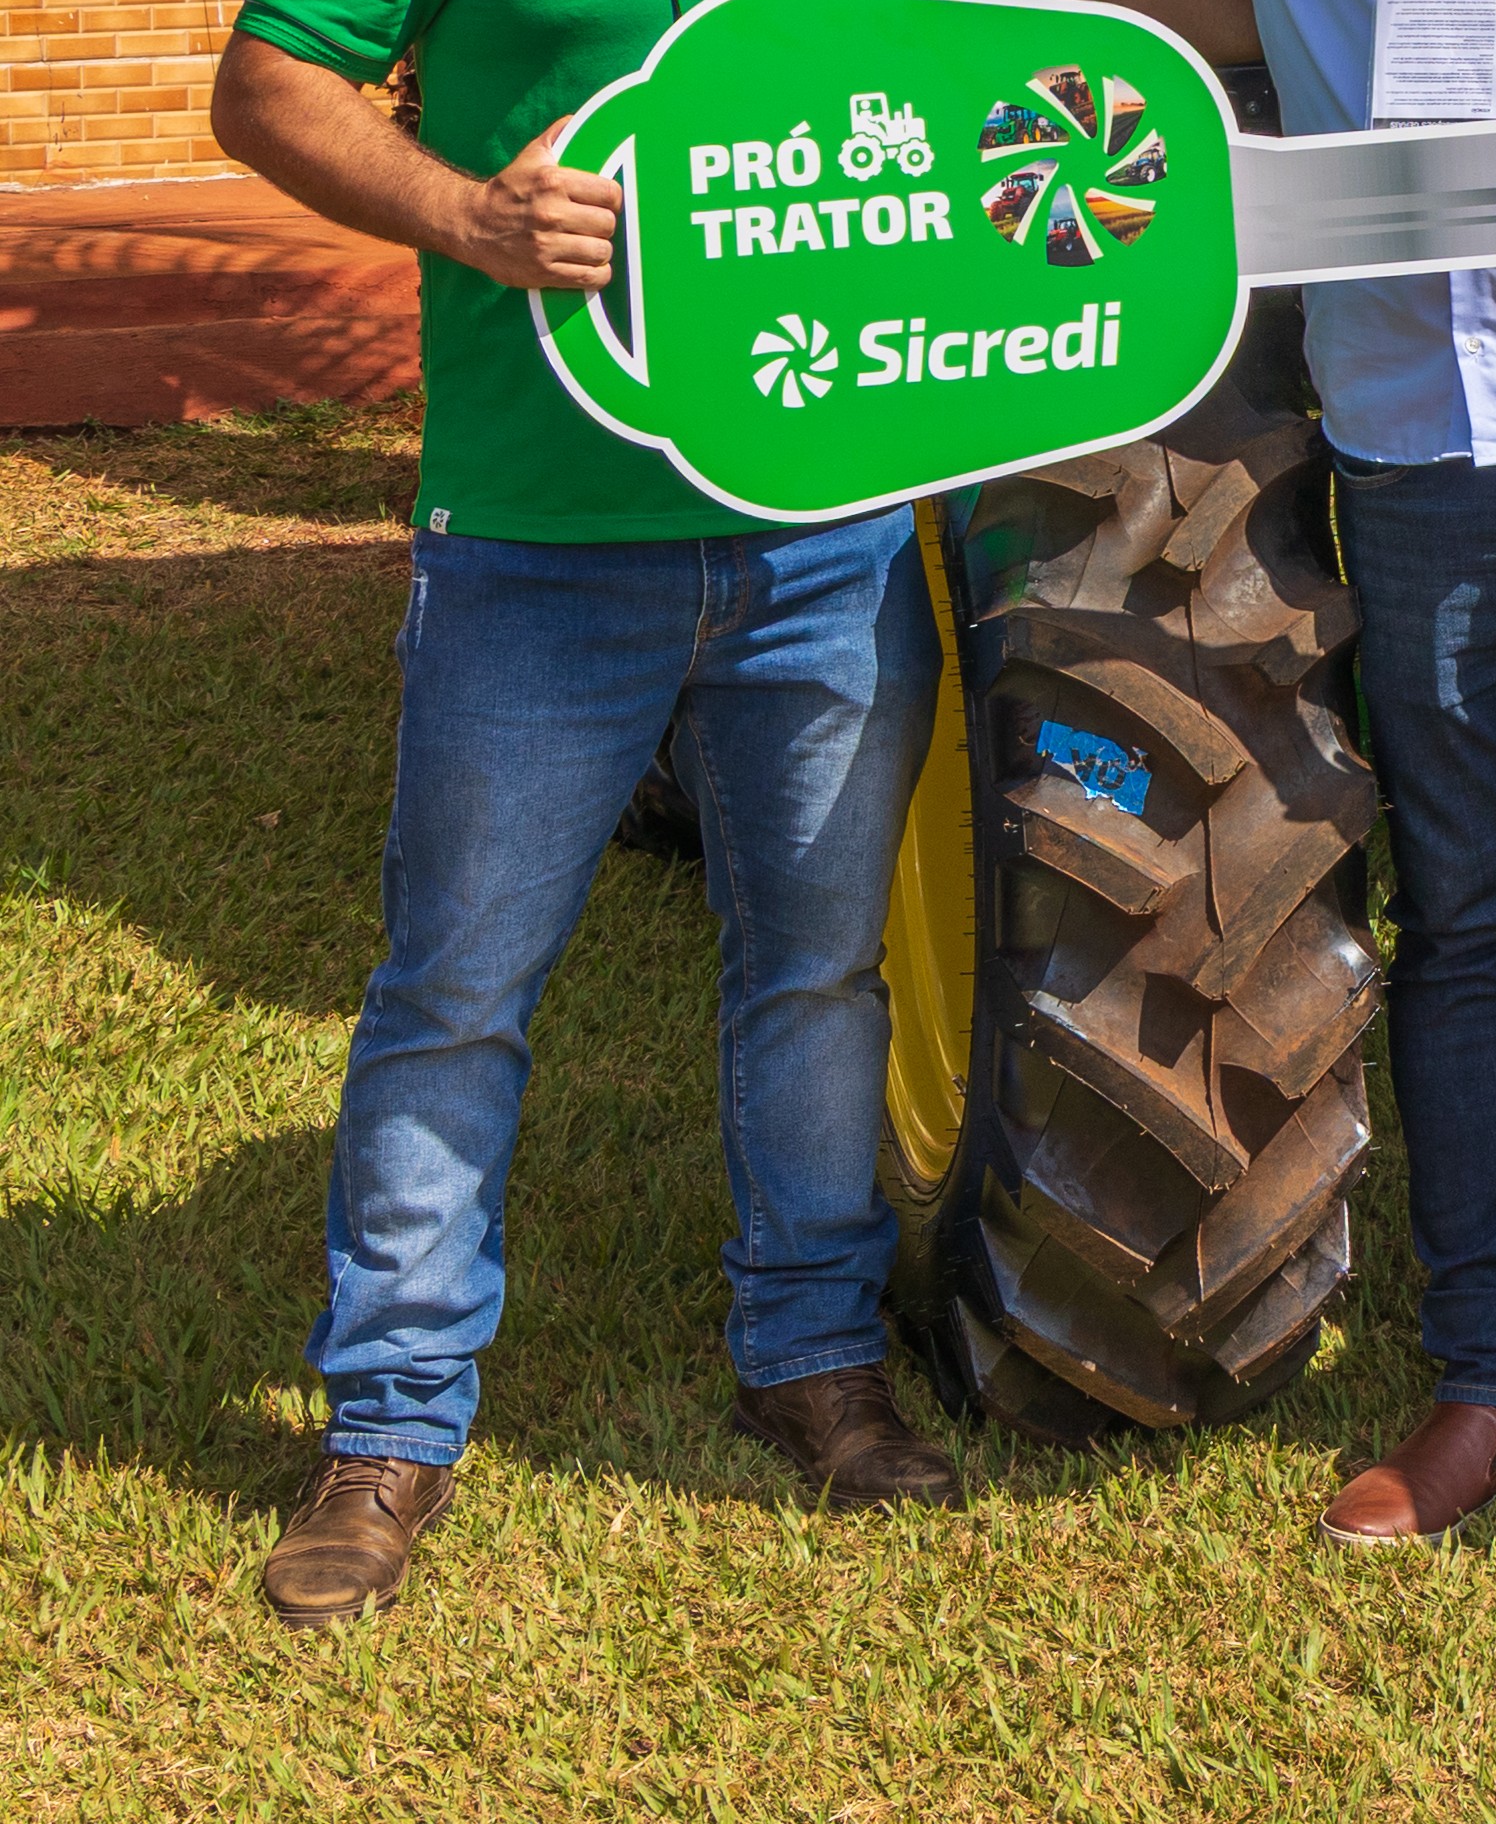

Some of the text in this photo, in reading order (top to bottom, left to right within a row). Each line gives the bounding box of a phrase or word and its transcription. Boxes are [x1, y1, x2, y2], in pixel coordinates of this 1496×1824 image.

[688, 120, 822, 196] PRÓ
[690, 190, 954, 260] TRATOR
[857, 301, 1122, 387] Sicredi
